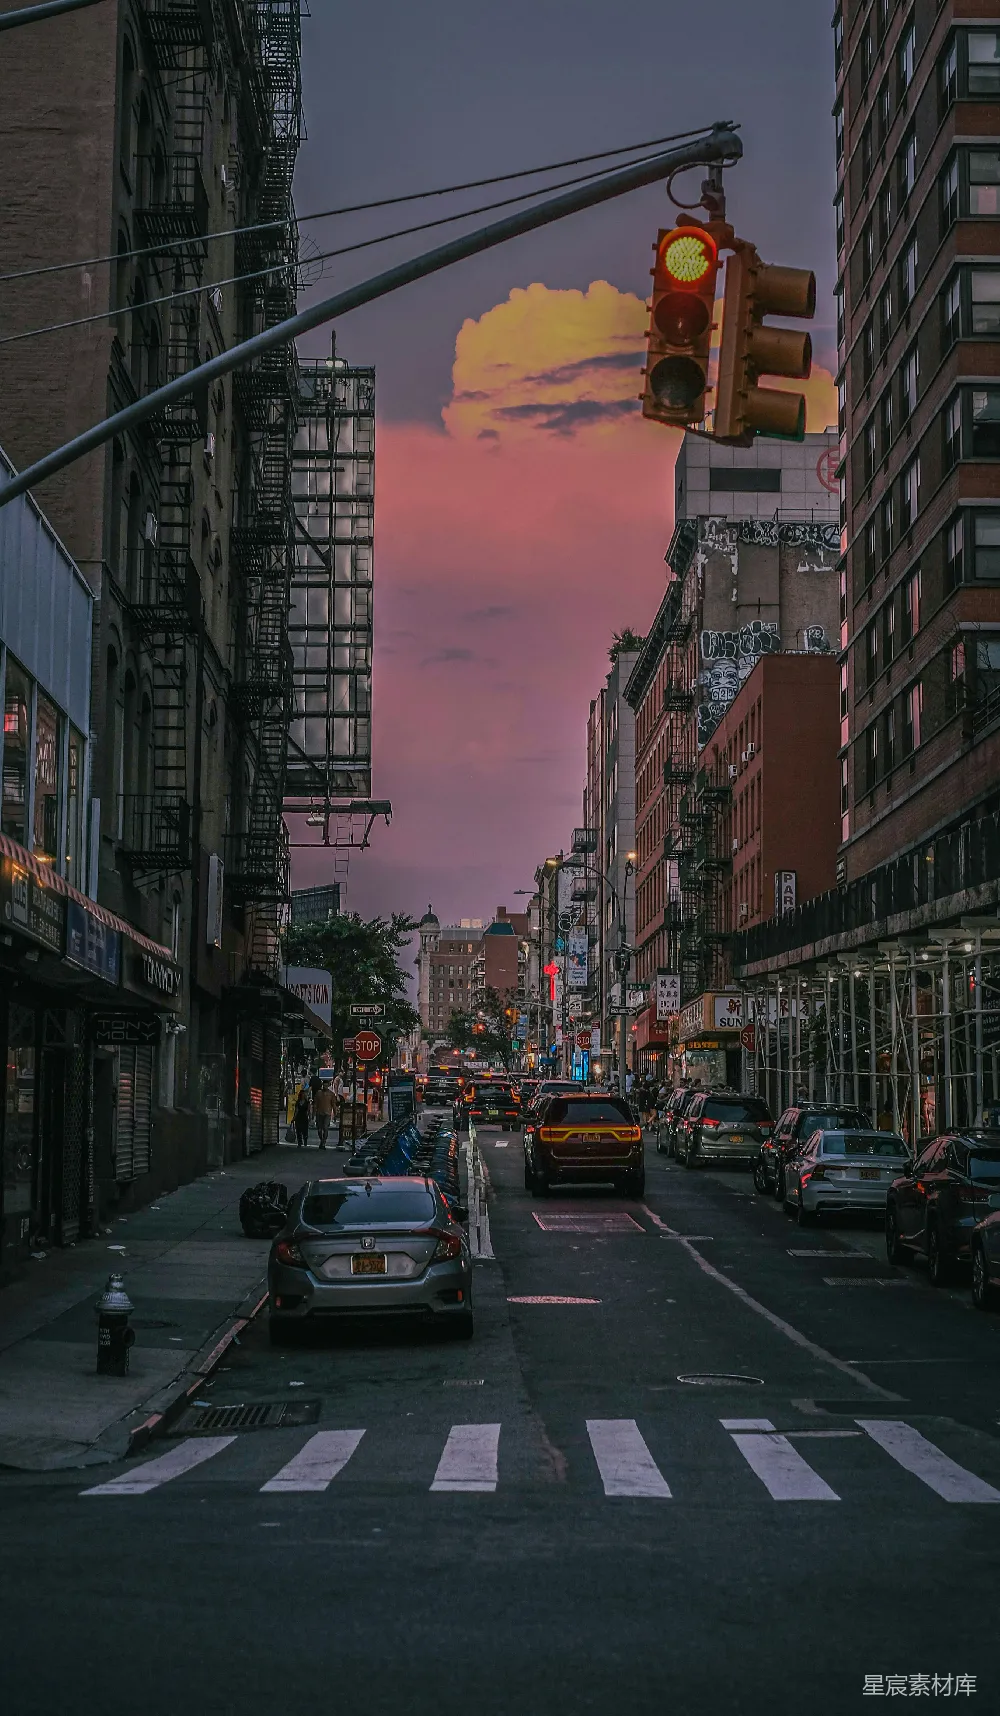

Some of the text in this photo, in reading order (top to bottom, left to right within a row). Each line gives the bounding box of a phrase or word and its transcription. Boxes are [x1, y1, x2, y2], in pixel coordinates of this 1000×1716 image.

[97, 1019, 157, 1030] TONY
[719, 1017, 742, 1027] SUN
[96, 1031, 156, 1041] MOLY
[355, 1040, 380, 1052] STOP
